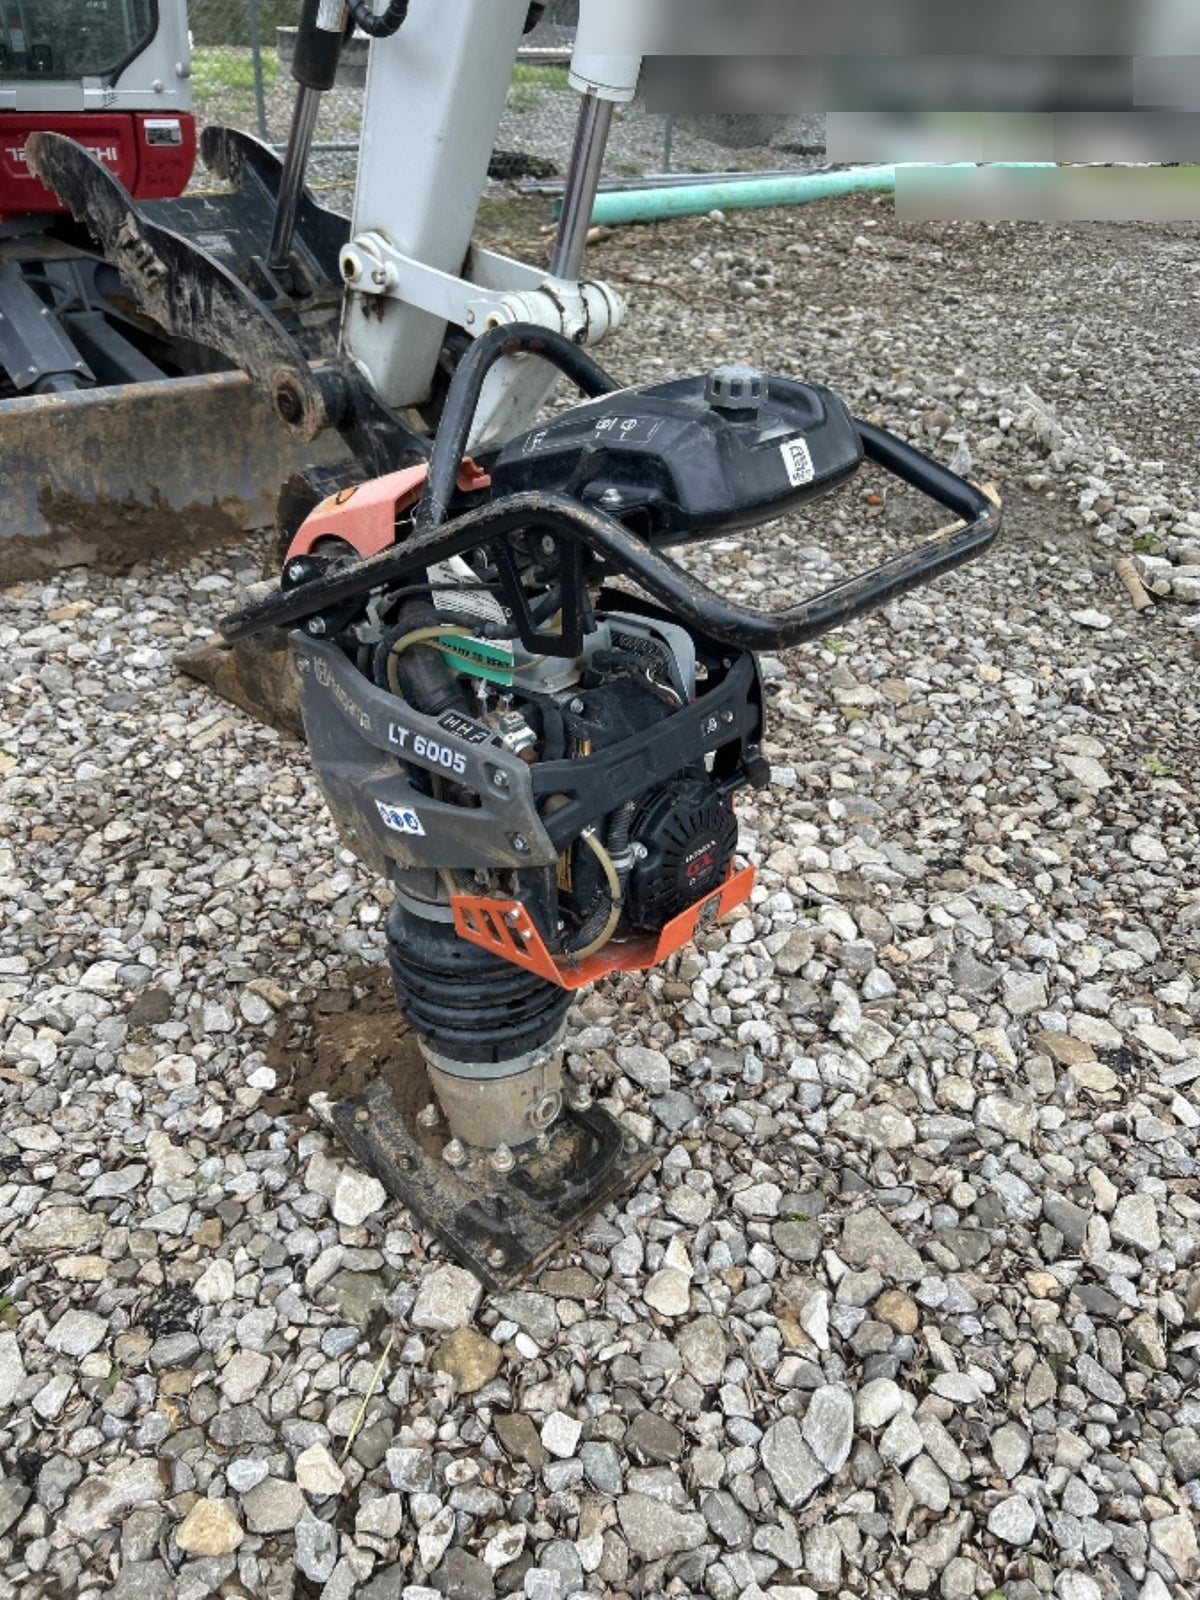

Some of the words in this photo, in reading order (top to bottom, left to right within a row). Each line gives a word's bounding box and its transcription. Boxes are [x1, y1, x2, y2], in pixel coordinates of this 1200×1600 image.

[5, 147, 118, 161] TAHI
[388, 722, 410, 748] LT
[413, 734, 467, 774] 6005
